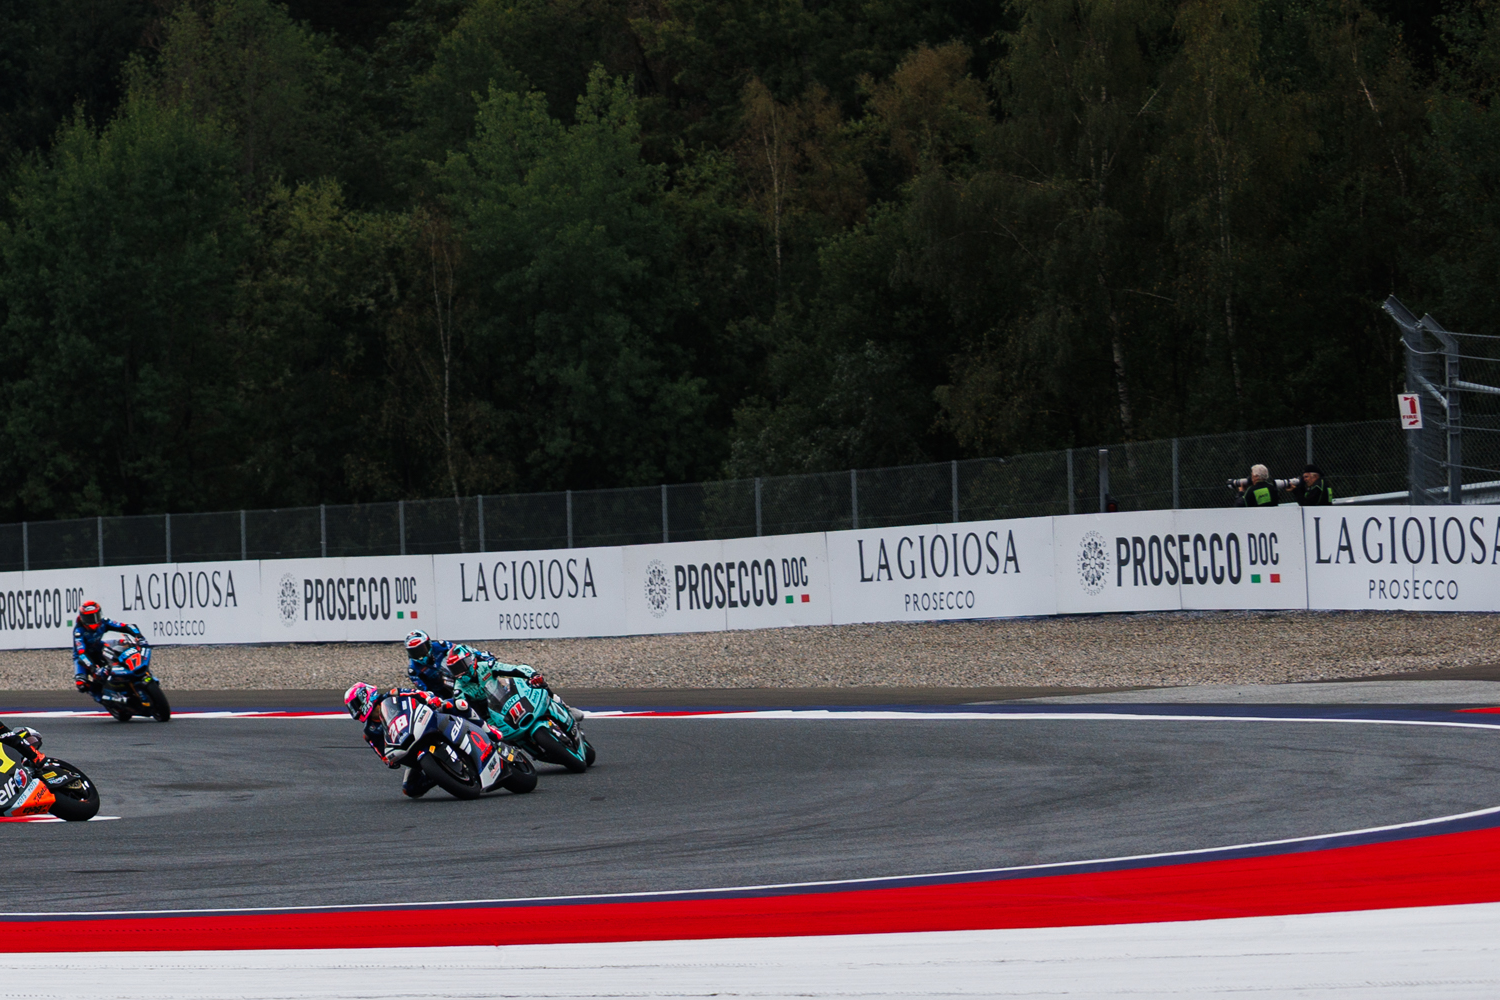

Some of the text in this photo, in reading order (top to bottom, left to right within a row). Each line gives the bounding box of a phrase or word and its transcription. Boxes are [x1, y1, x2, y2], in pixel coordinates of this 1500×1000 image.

[1116, 532, 1280, 588] PROSECCO DOC
[674, 558, 779, 611] PROSECCO
[783, 556, 810, 588] DOC
[1368, 578, 1459, 601] PROSECCO
[304, 577, 392, 621] PROSECCO
[395, 576, 418, 605] DOC
[904, 589, 976, 613] PROSECCO
[152, 619, 206, 637] PROSECCO
[498, 611, 560, 631] PROSECCO
[125, 652, 142, 672] 17
[509, 701, 526, 724] 11
[388, 713, 409, 744] 28
